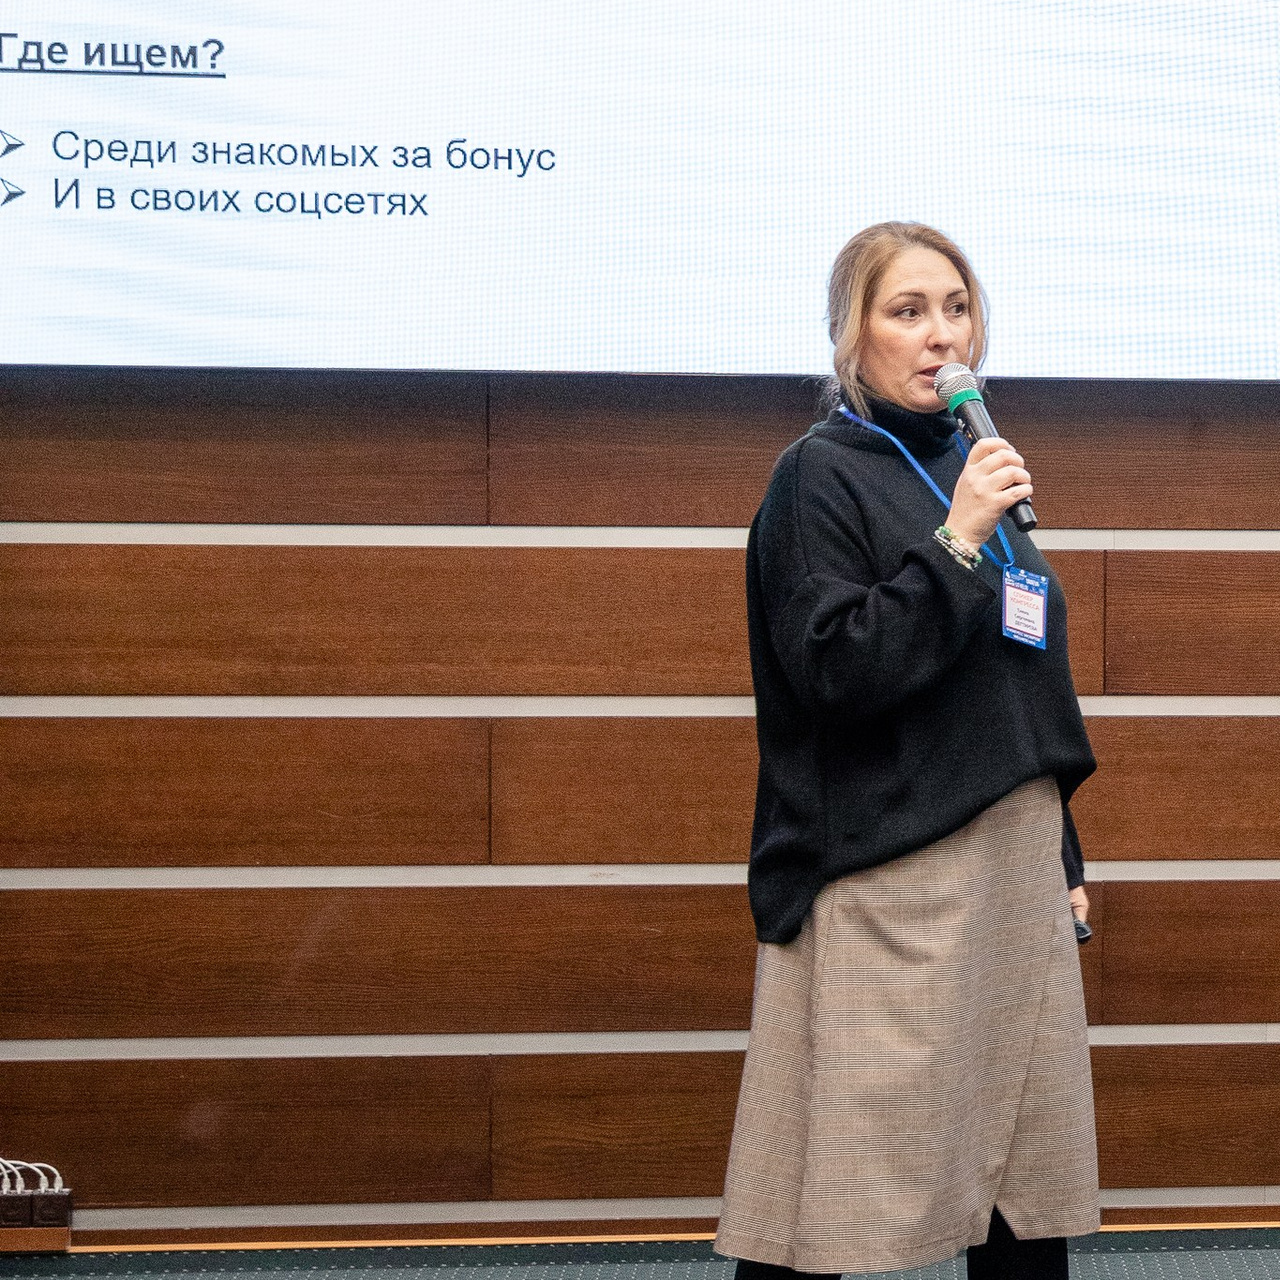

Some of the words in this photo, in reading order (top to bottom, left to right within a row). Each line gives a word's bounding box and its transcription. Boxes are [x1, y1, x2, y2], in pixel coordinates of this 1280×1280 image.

[83, 38, 225, 70] ищем?
[51, 129, 177, 170] Среди
[191, 140, 379, 168] знакомых
[391, 145, 432, 169] за
[445, 137, 556, 179] бонус
[53, 177, 81, 210] И
[95, 186, 117, 211] в
[129, 187, 242, 213] своих
[253, 190, 429, 220] соцсетях
